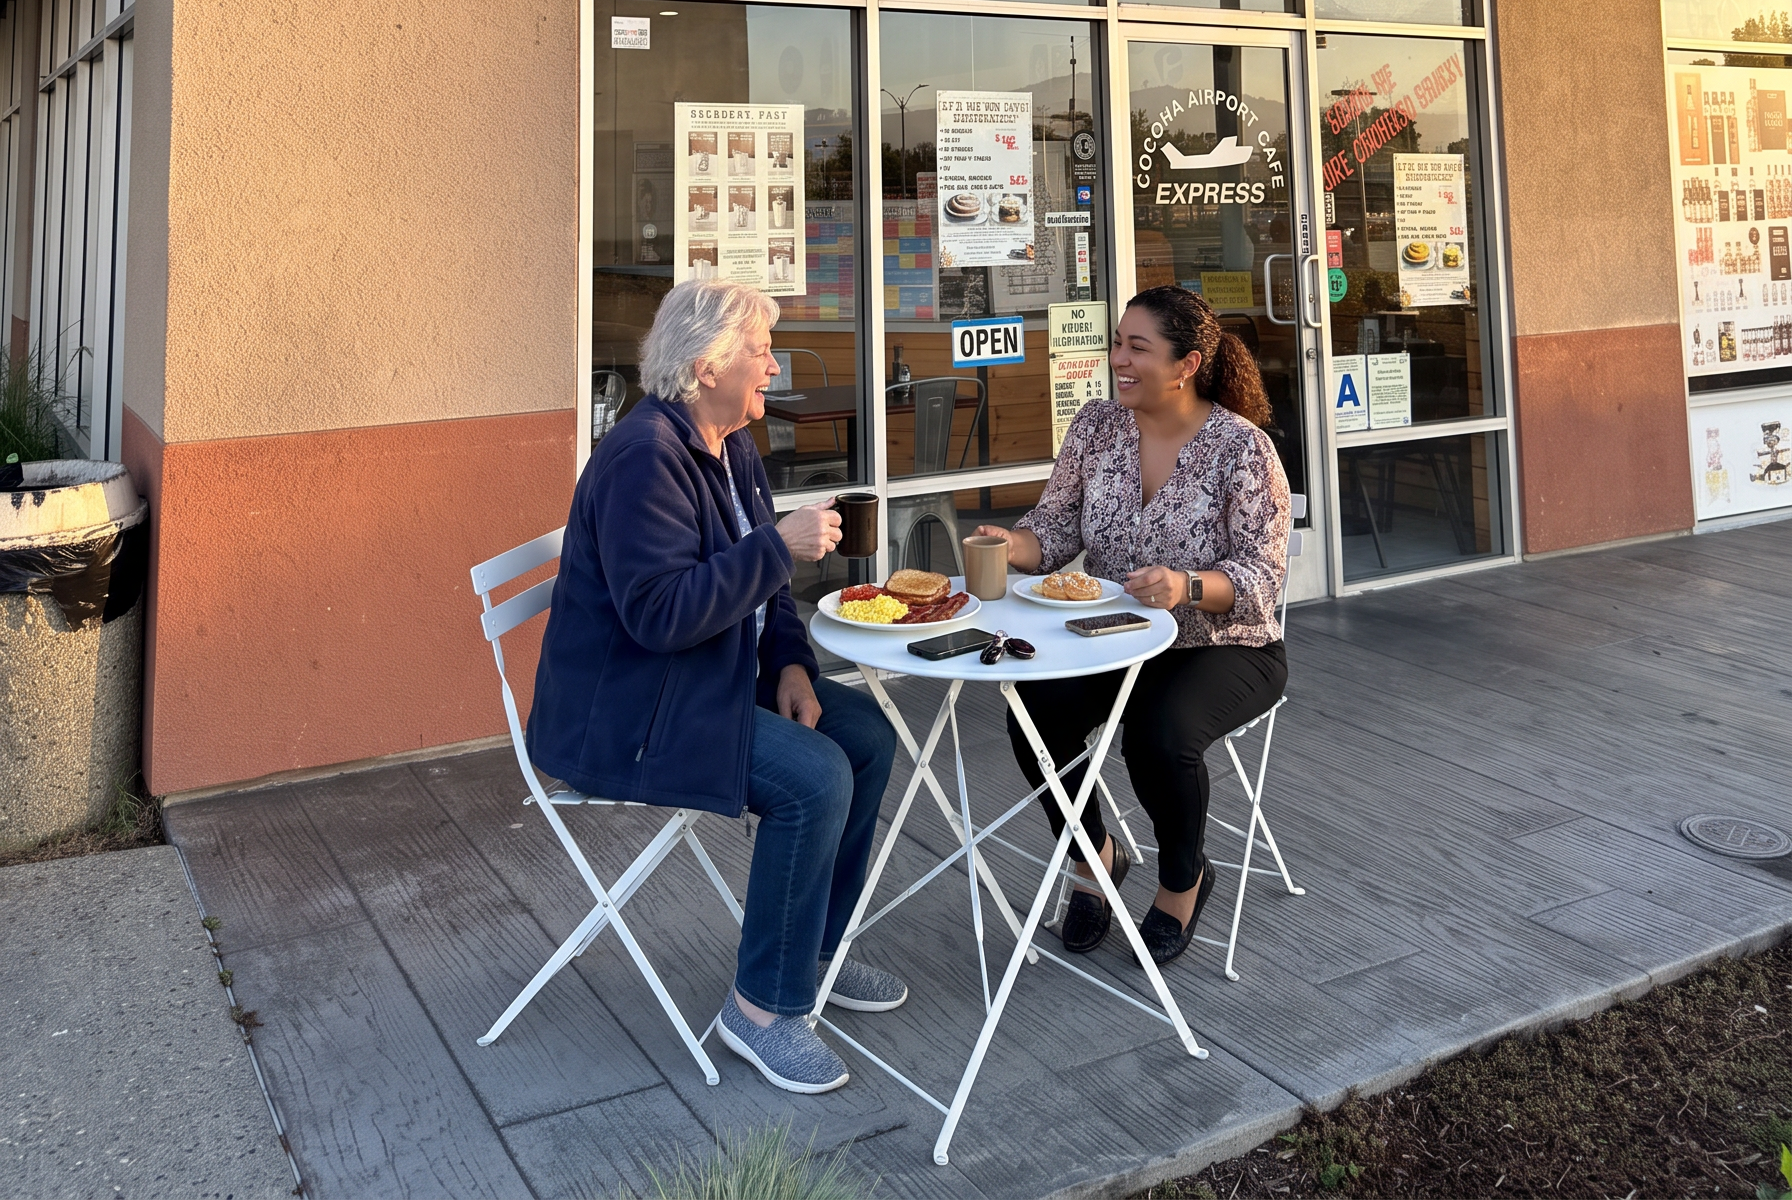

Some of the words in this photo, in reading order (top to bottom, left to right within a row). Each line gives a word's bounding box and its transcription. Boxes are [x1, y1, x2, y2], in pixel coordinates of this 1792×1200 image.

[1188, 89, 1259, 128] AIRPORT
[1257, 129, 1285, 189] CAFE
[1155, 182, 1266, 205] EXPRESS
[1071, 309, 1086, 319] NO
[960, 326, 1019, 358] OPEN
[1336, 373, 1361, 409] A
